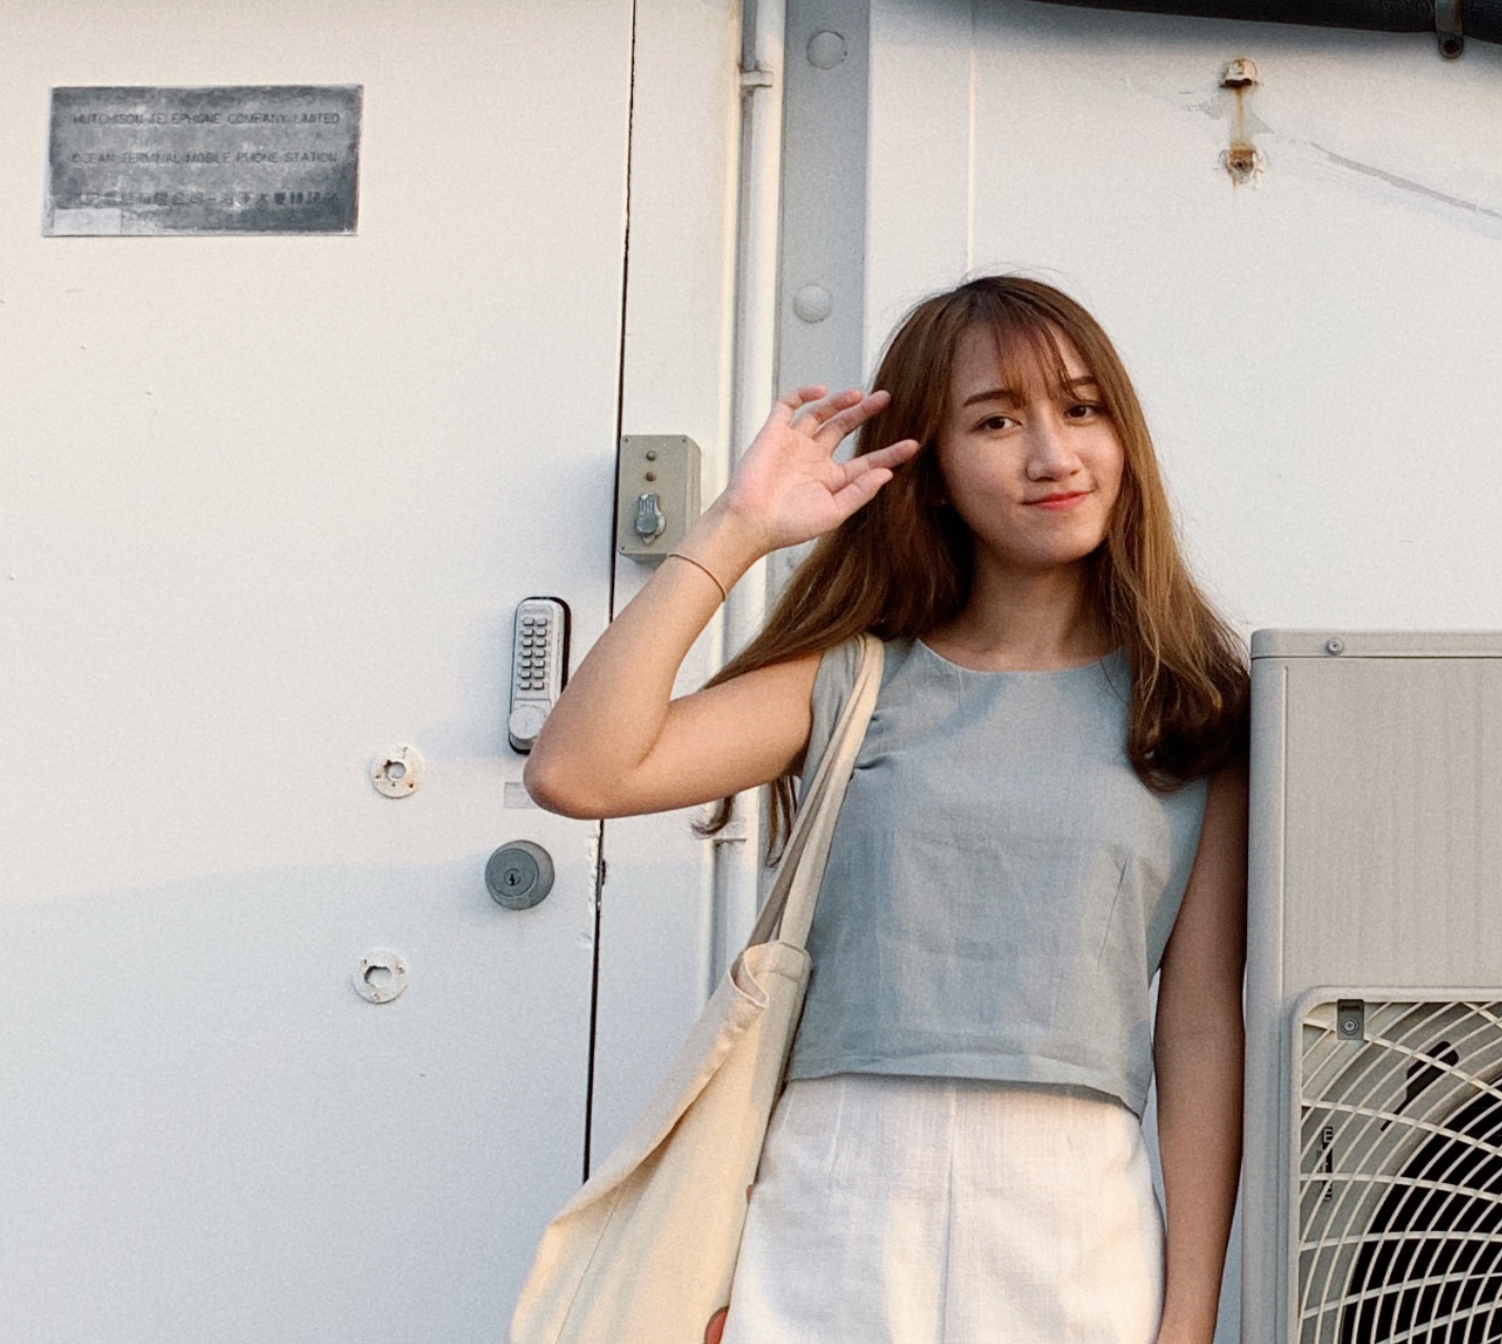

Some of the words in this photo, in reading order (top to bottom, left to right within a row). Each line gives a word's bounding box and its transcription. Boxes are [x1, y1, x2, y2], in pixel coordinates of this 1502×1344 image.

[73, 113, 144, 125] HUTCHISON
[149, 113, 221, 125] TELEPHONE
[227, 113, 289, 125] COMPANY
[294, 113, 340, 125] LIMITED
